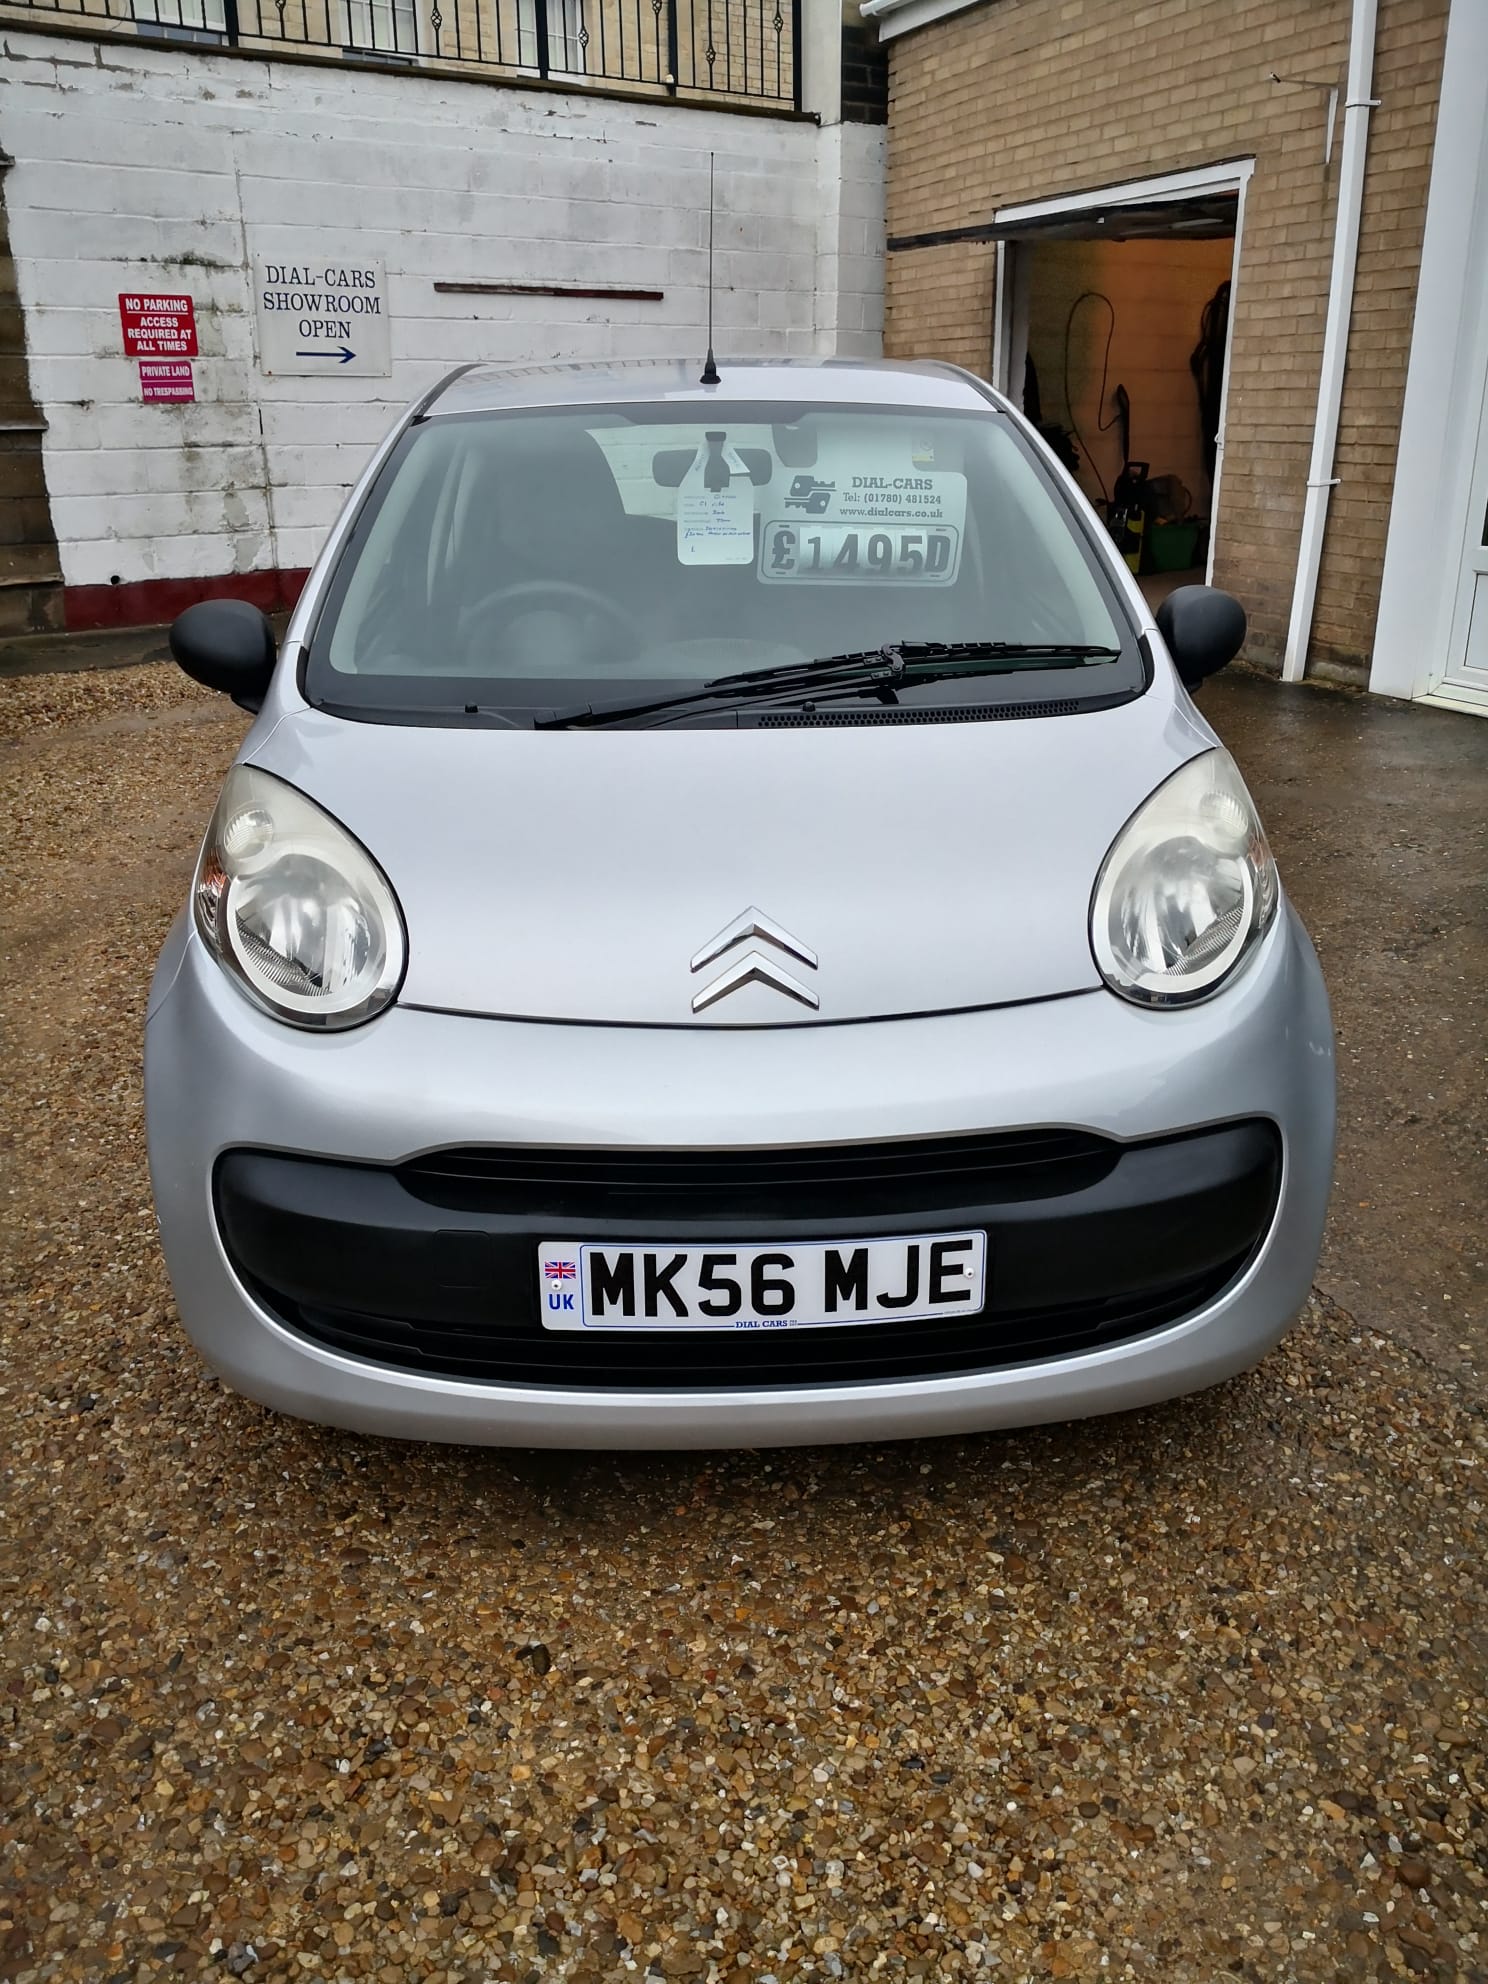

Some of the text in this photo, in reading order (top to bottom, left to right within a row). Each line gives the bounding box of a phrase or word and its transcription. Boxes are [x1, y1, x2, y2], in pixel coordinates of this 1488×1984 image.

[265, 265, 376, 289] DIAL-CARS
[125, 298, 188, 312] NO PARKING
[263, 291, 381, 315] SHOWROOM
[140, 316, 178, 328] ACCESS
[127, 328, 192, 340] REQUIRED AT
[299, 319, 351, 339] OPEN
[136, 340, 188, 351] ALL TIMES
[141, 366, 190, 377] PRIVATE LAND
[143, 387, 153, 396] NO
[852, 476, 934, 490] DIAL-CARS
[842, 492, 942, 505] Tel: (01780) 481524
[839, 507, 944, 518] www.dialcars.co.uk
[589, 1238, 974, 1318] MK56 MJE
[549, 1293, 575, 1311] UK
[735, 1320, 760, 1329] DIAL
[762, 1320, 788, 1328] CARS
